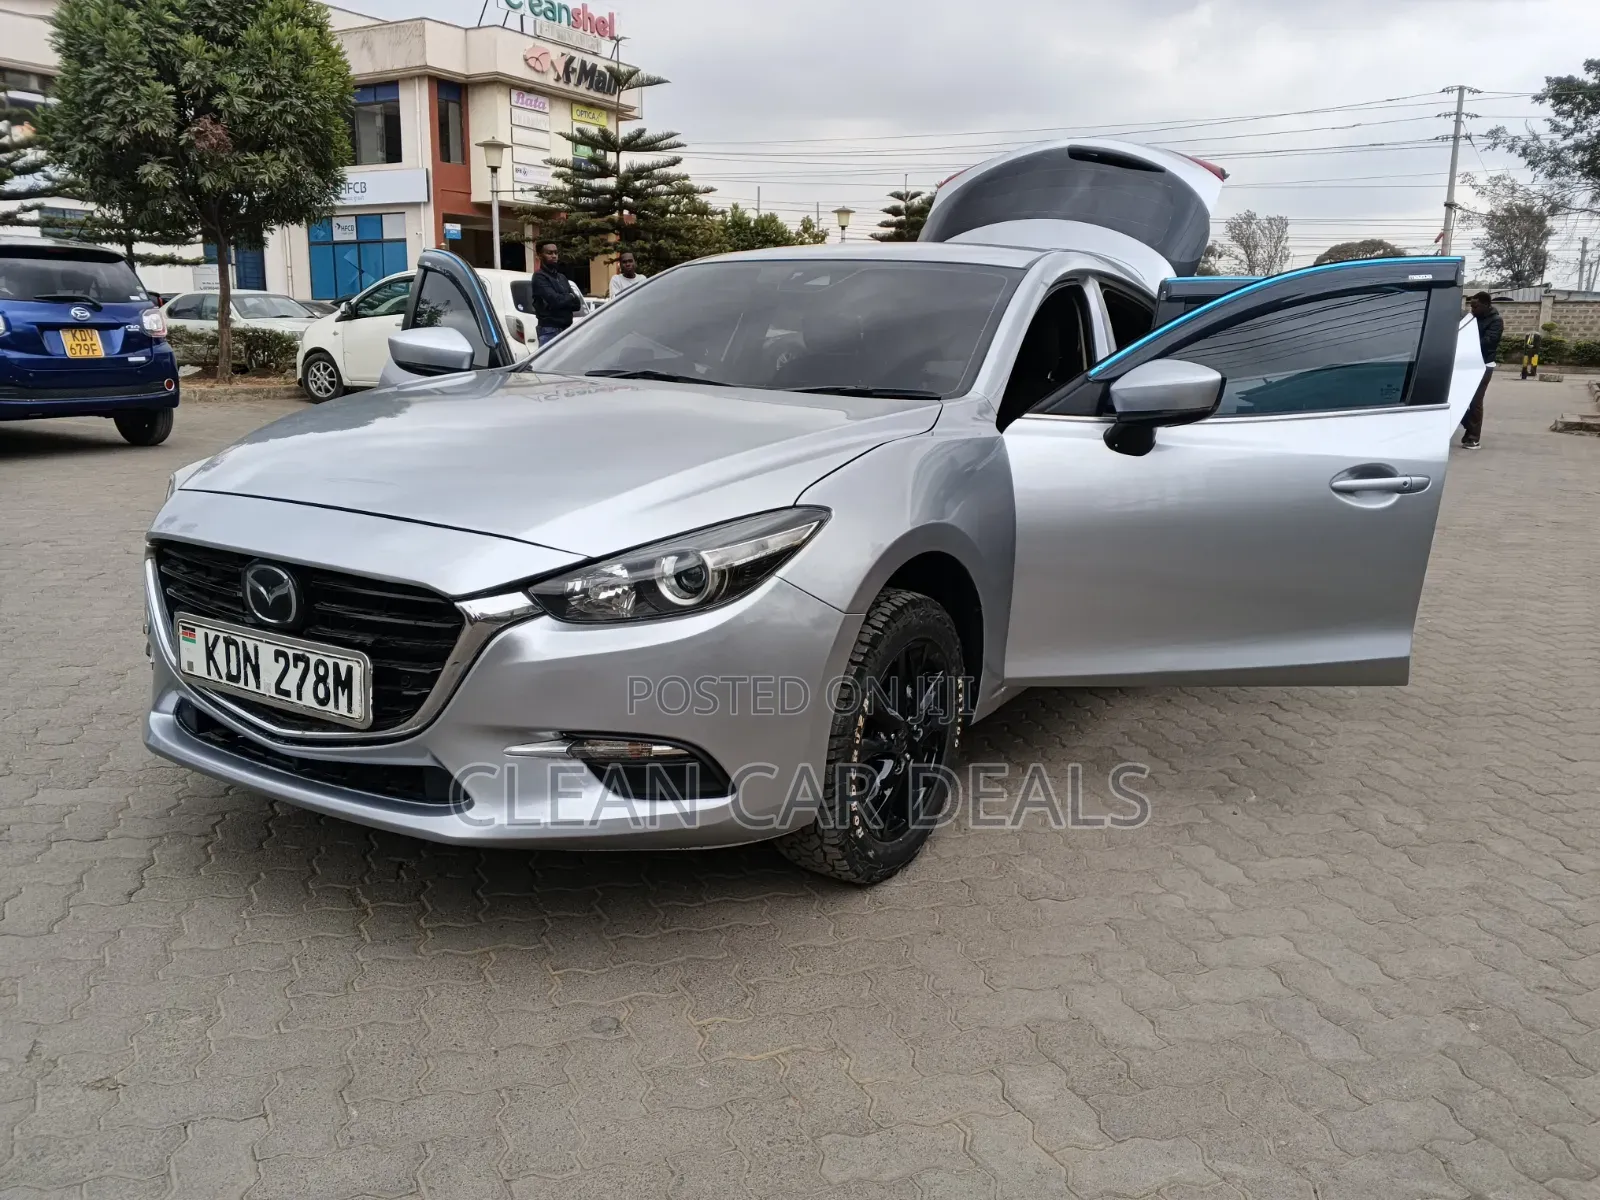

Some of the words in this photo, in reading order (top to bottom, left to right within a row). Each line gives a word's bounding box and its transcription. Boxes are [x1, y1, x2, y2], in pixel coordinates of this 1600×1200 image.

[515, 91, 547, 110] Bata
[71, 330, 94, 341] KDV
[69, 344, 97, 355] 679F
[203, 631, 262, 690] KDN
[273, 648, 354, 714] 278M
